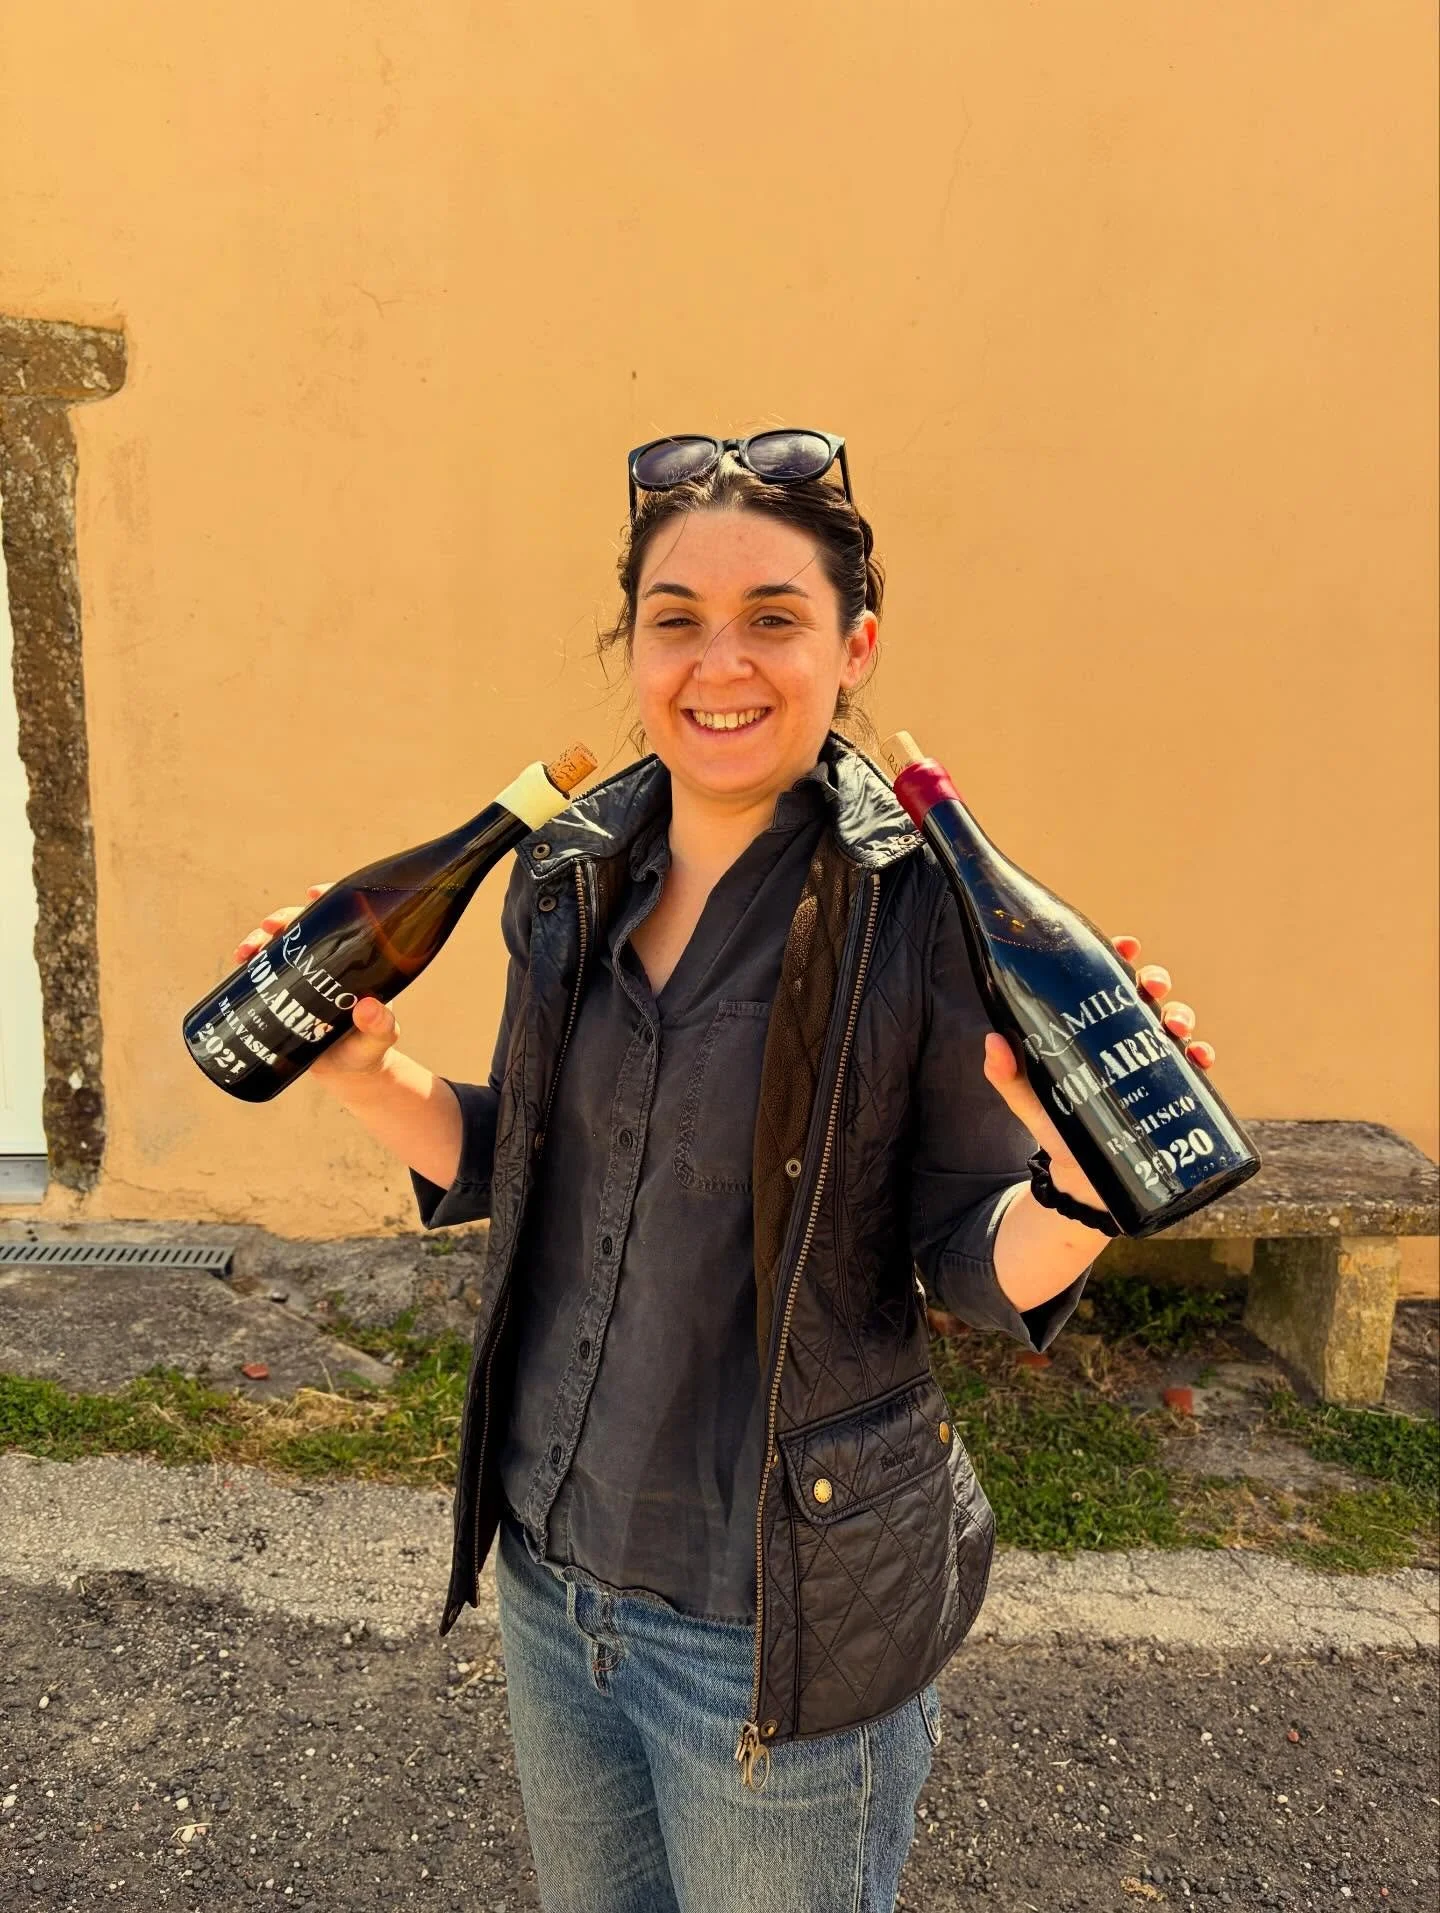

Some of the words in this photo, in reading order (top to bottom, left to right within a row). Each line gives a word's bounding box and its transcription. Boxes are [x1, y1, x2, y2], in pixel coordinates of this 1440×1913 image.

[248, 950, 333, 1043] COLARES
[282, 923, 357, 1010] RAMILO
[196, 1022, 247, 1074] 2021
[218, 997, 278, 1066] MALVASIA
[248, 1008, 269, 1031] DOC
[1023, 984, 1138, 1063] RAMILO
[1119, 1086, 1149, 1109] DOC
[1134, 1128, 1214, 1189] 2020
